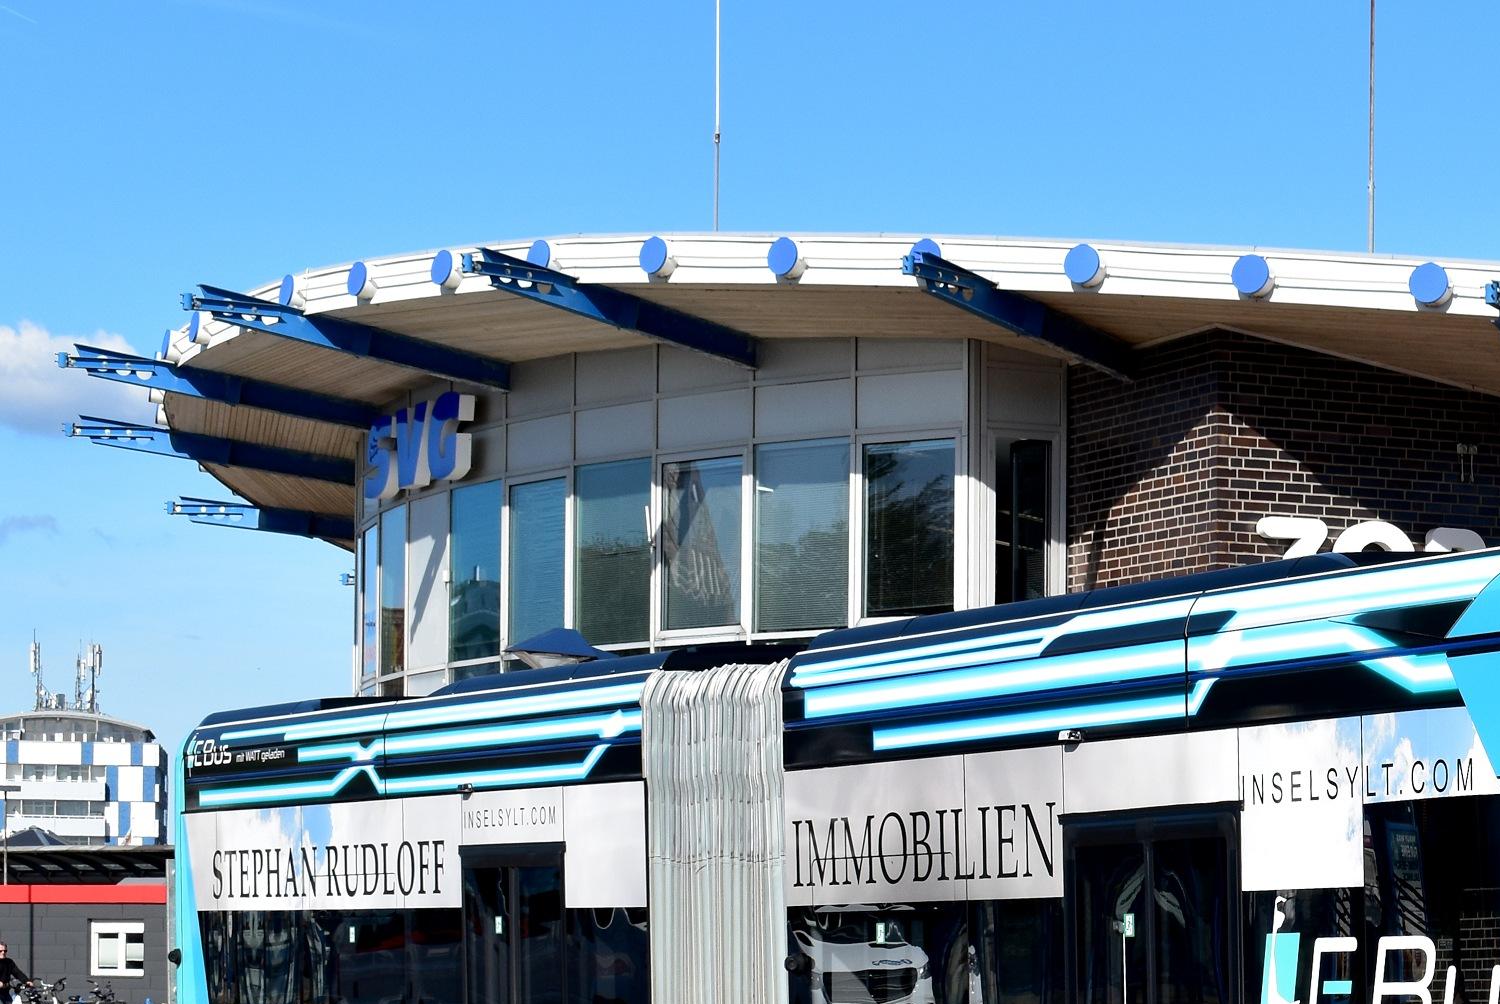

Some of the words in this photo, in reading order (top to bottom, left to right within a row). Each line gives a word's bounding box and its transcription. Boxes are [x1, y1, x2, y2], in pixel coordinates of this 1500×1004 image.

[364, 391, 475, 500] SVG
[1242, 757, 1474, 806] INSELSYLT.COM
[463, 804, 557, 829] INSELSYLT.COM
[793, 801, 1056, 887] IMMOBILIEN
[211, 846, 318, 900] STEPHAN
[325, 839, 446, 896] RUDLOFF
